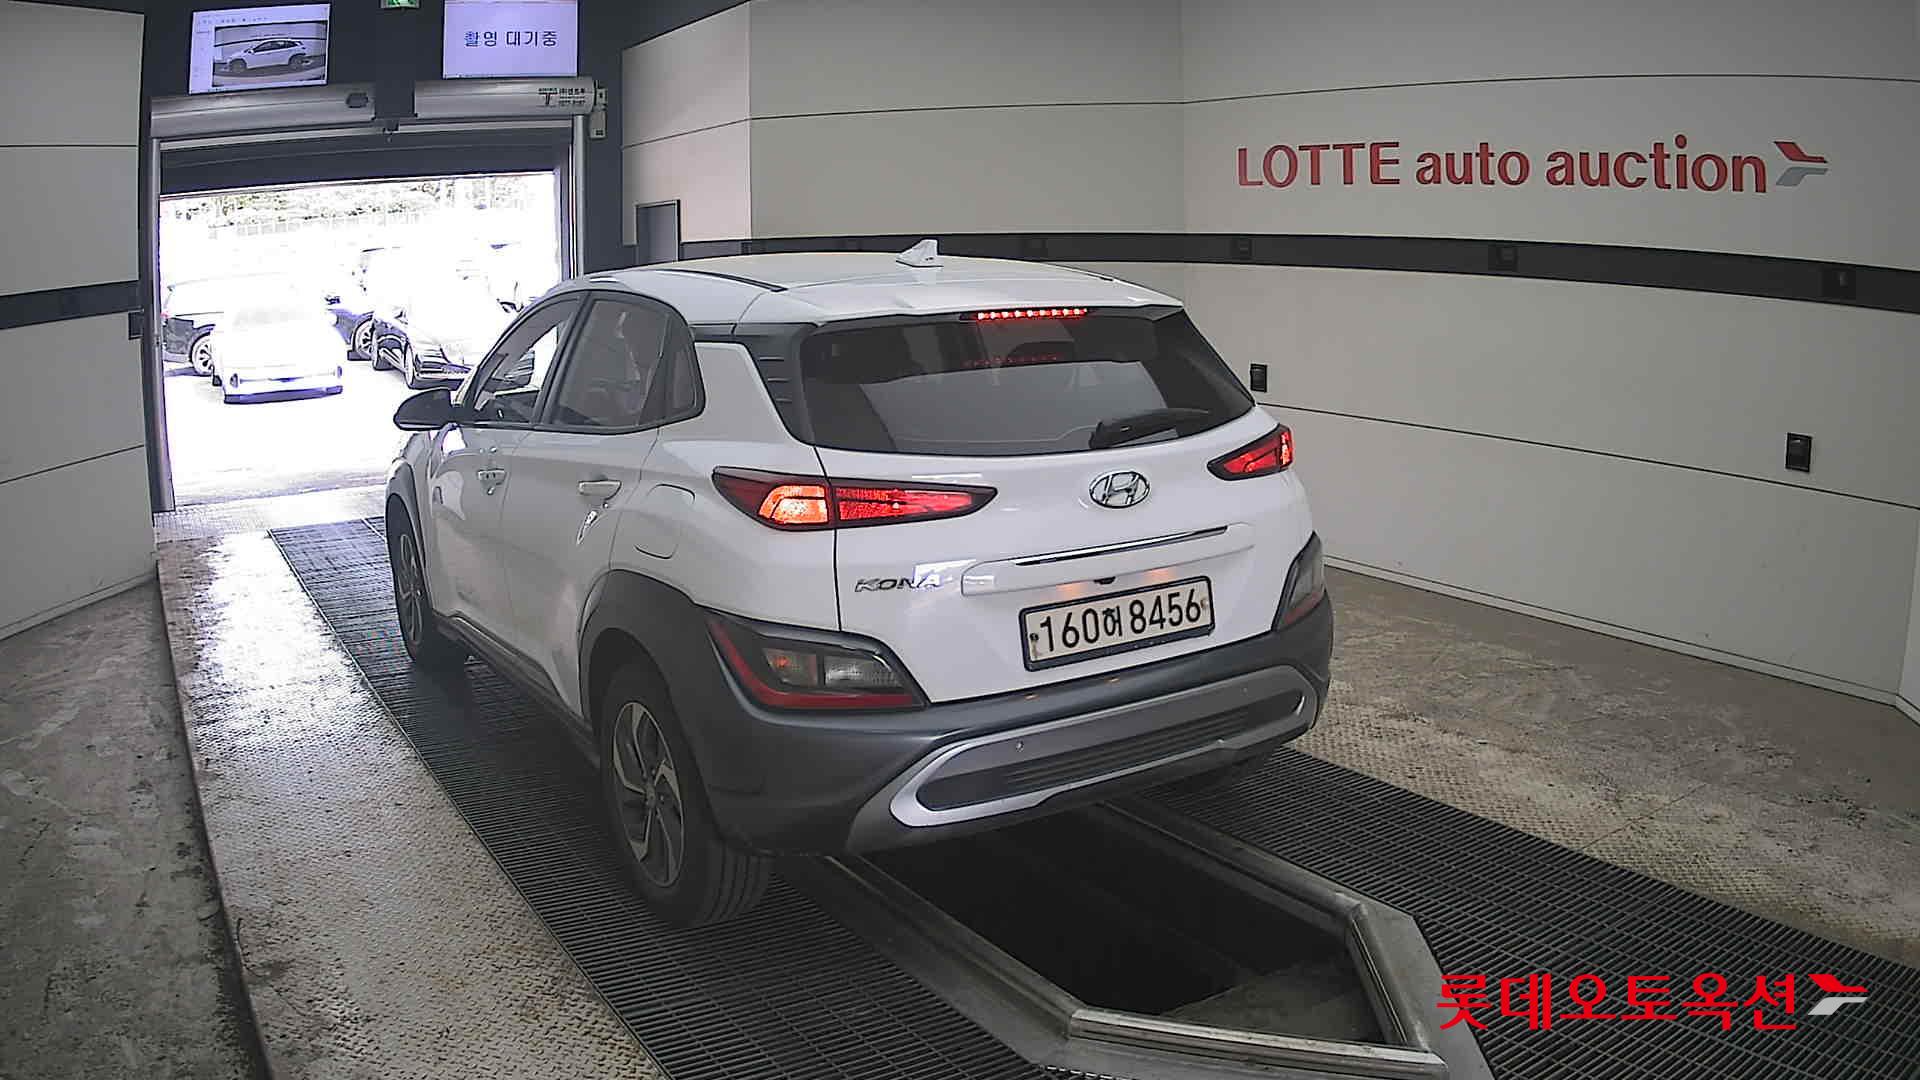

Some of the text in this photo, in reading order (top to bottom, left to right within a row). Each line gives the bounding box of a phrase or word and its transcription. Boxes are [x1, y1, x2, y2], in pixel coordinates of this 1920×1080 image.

[465, 31, 557, 47] 촬영 대기중
[1238, 134, 1766, 194] LOTTE auto auction
[855, 577, 942, 592] KONA
